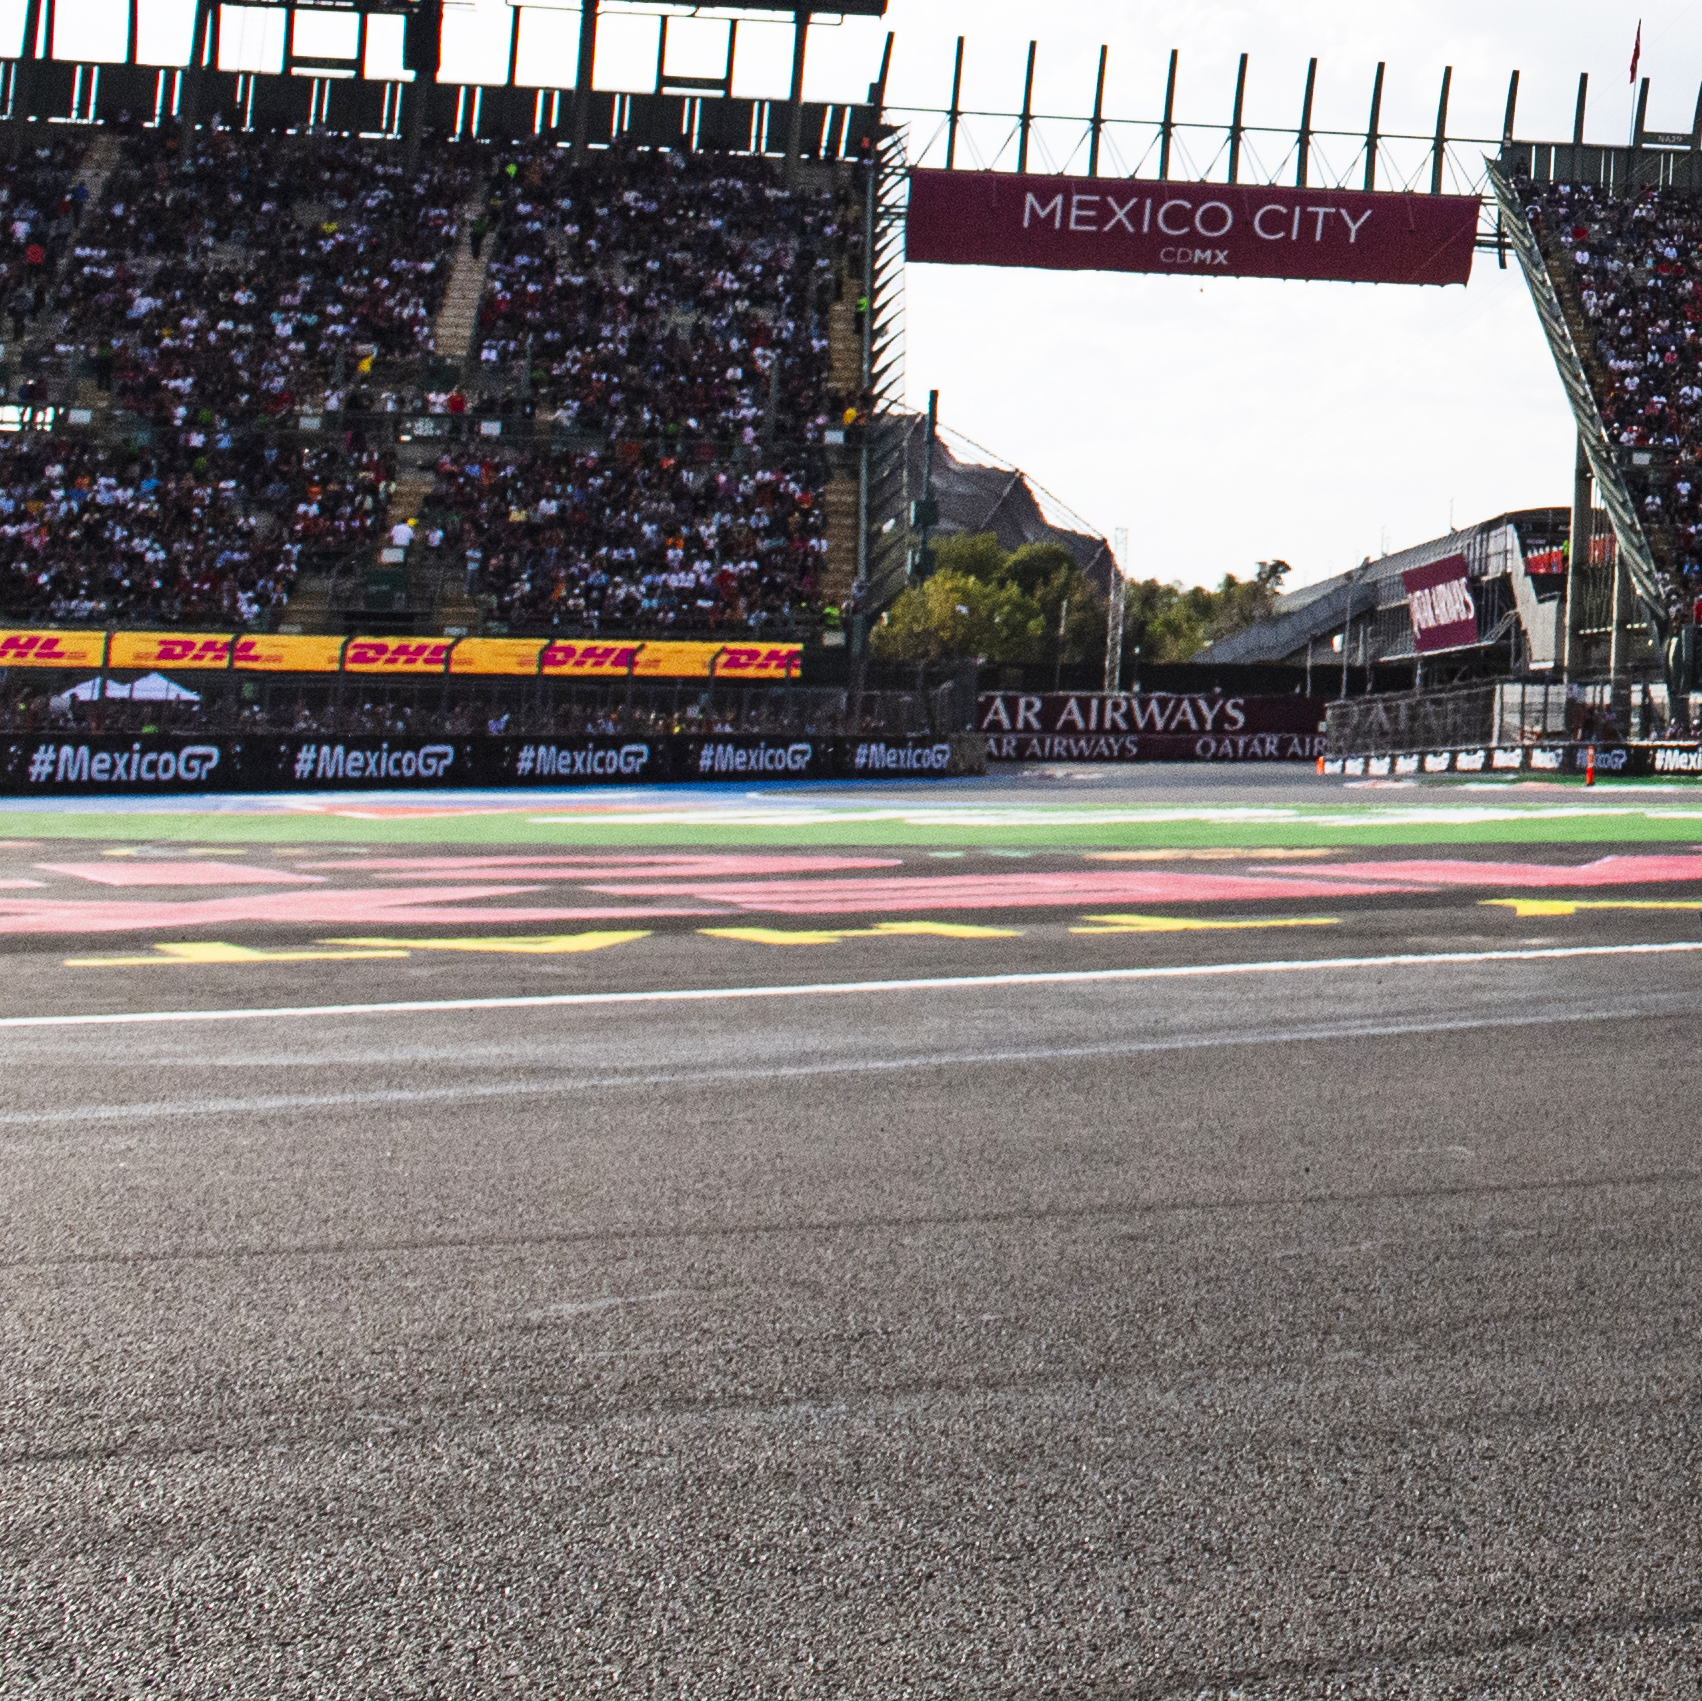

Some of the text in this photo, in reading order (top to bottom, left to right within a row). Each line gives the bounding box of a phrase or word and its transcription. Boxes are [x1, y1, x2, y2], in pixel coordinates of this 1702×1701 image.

[1022, 191, 1373, 244] MEXICO CITY
[1159, 246, 1229, 265] CDMX
[156, 639, 262, 661] DHL
[541, 645, 639, 668] DHL
[1055, 696, 1247, 732] AIRWAYS
[29, 741, 222, 782] #MexicoGP
[295, 741, 455, 779] #MexicoGP
[517, 741, 650, 776] #MexicoGP
[700, 742, 812, 773] #MexicoGP
[855, 740, 951, 771] #MexicoGP
[1022, 736, 1140, 759] AIRWAYS
[1194, 735, 1281, 759] QATAR
